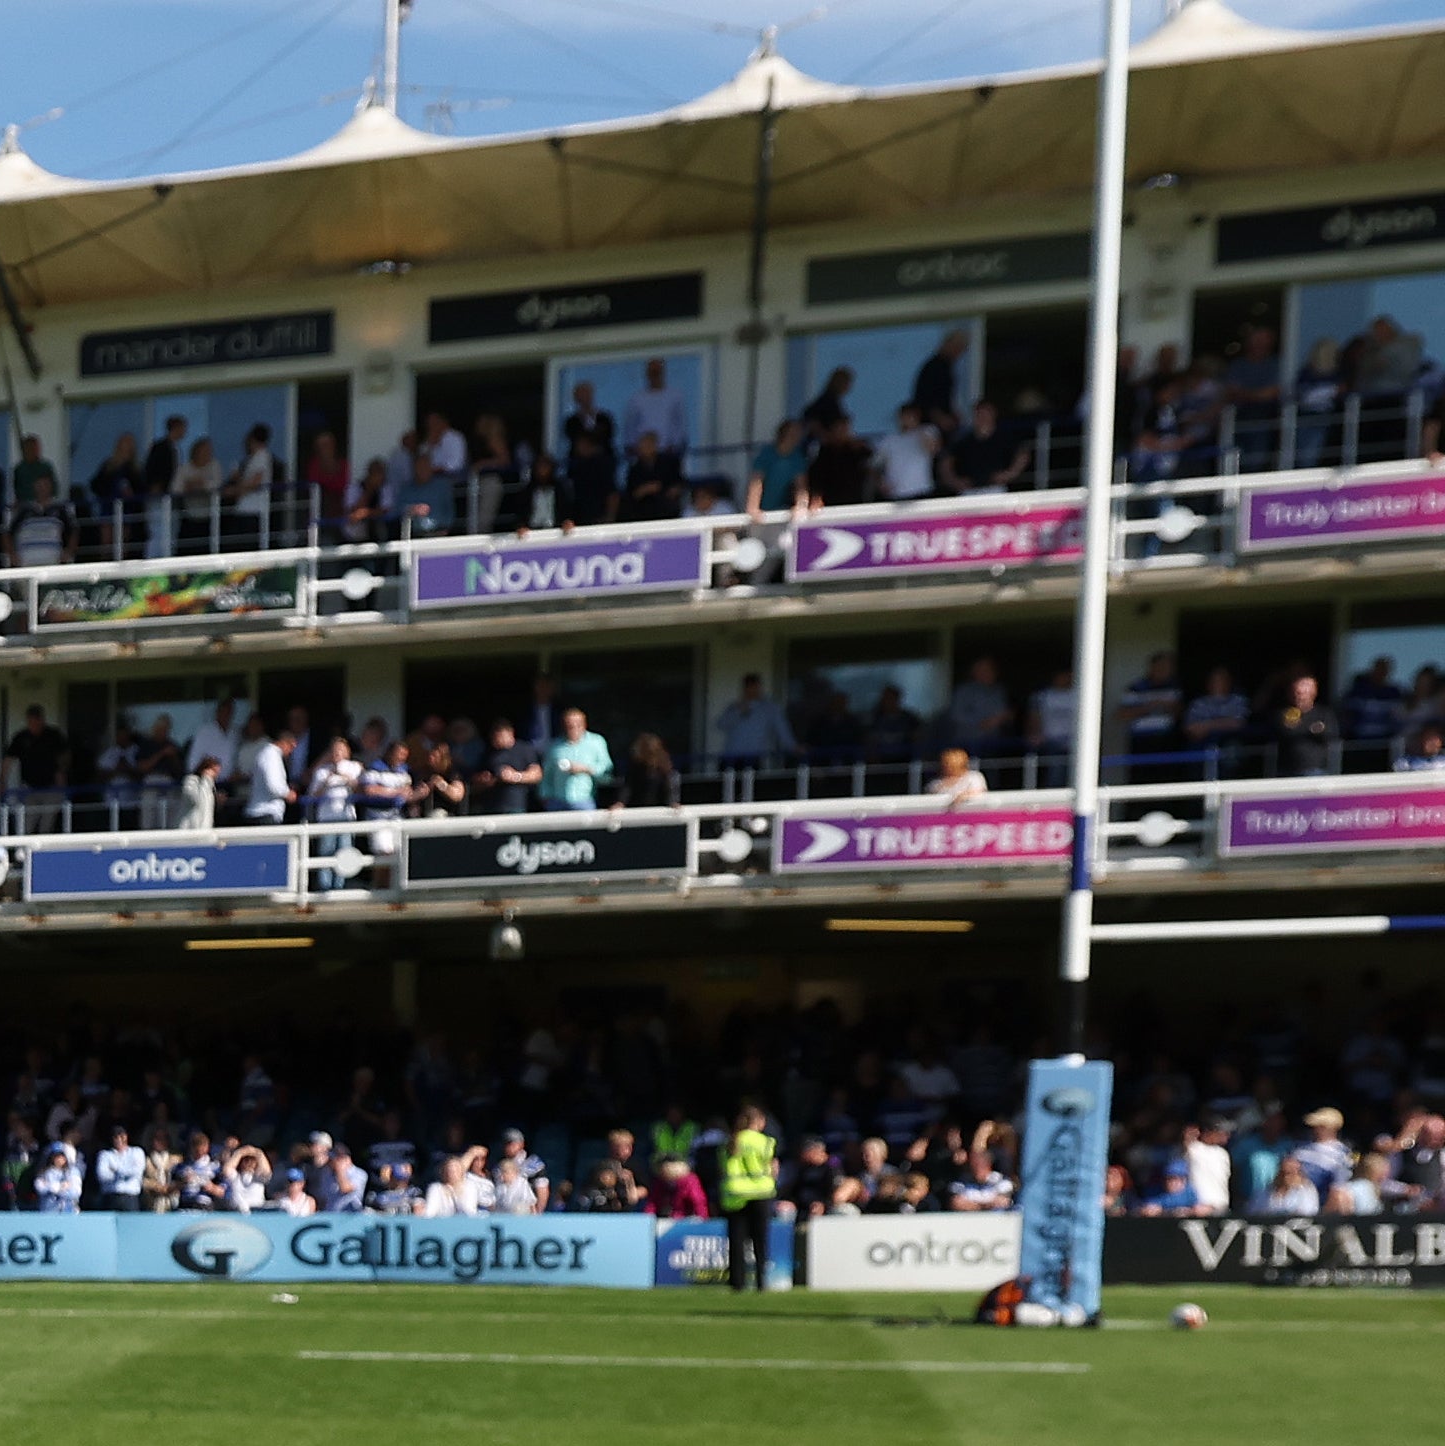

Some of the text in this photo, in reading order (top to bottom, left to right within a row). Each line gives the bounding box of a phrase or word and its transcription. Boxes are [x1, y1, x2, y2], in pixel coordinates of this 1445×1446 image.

[464, 552, 645, 595] Novuna
[495, 834, 596, 875] dyson
[852, 820, 1075, 857] TRUESPEED
[110, 851, 207, 884] ontrac
[291, 1222, 597, 1278] Gallagher
[867, 1231, 1013, 1268] ontrac
